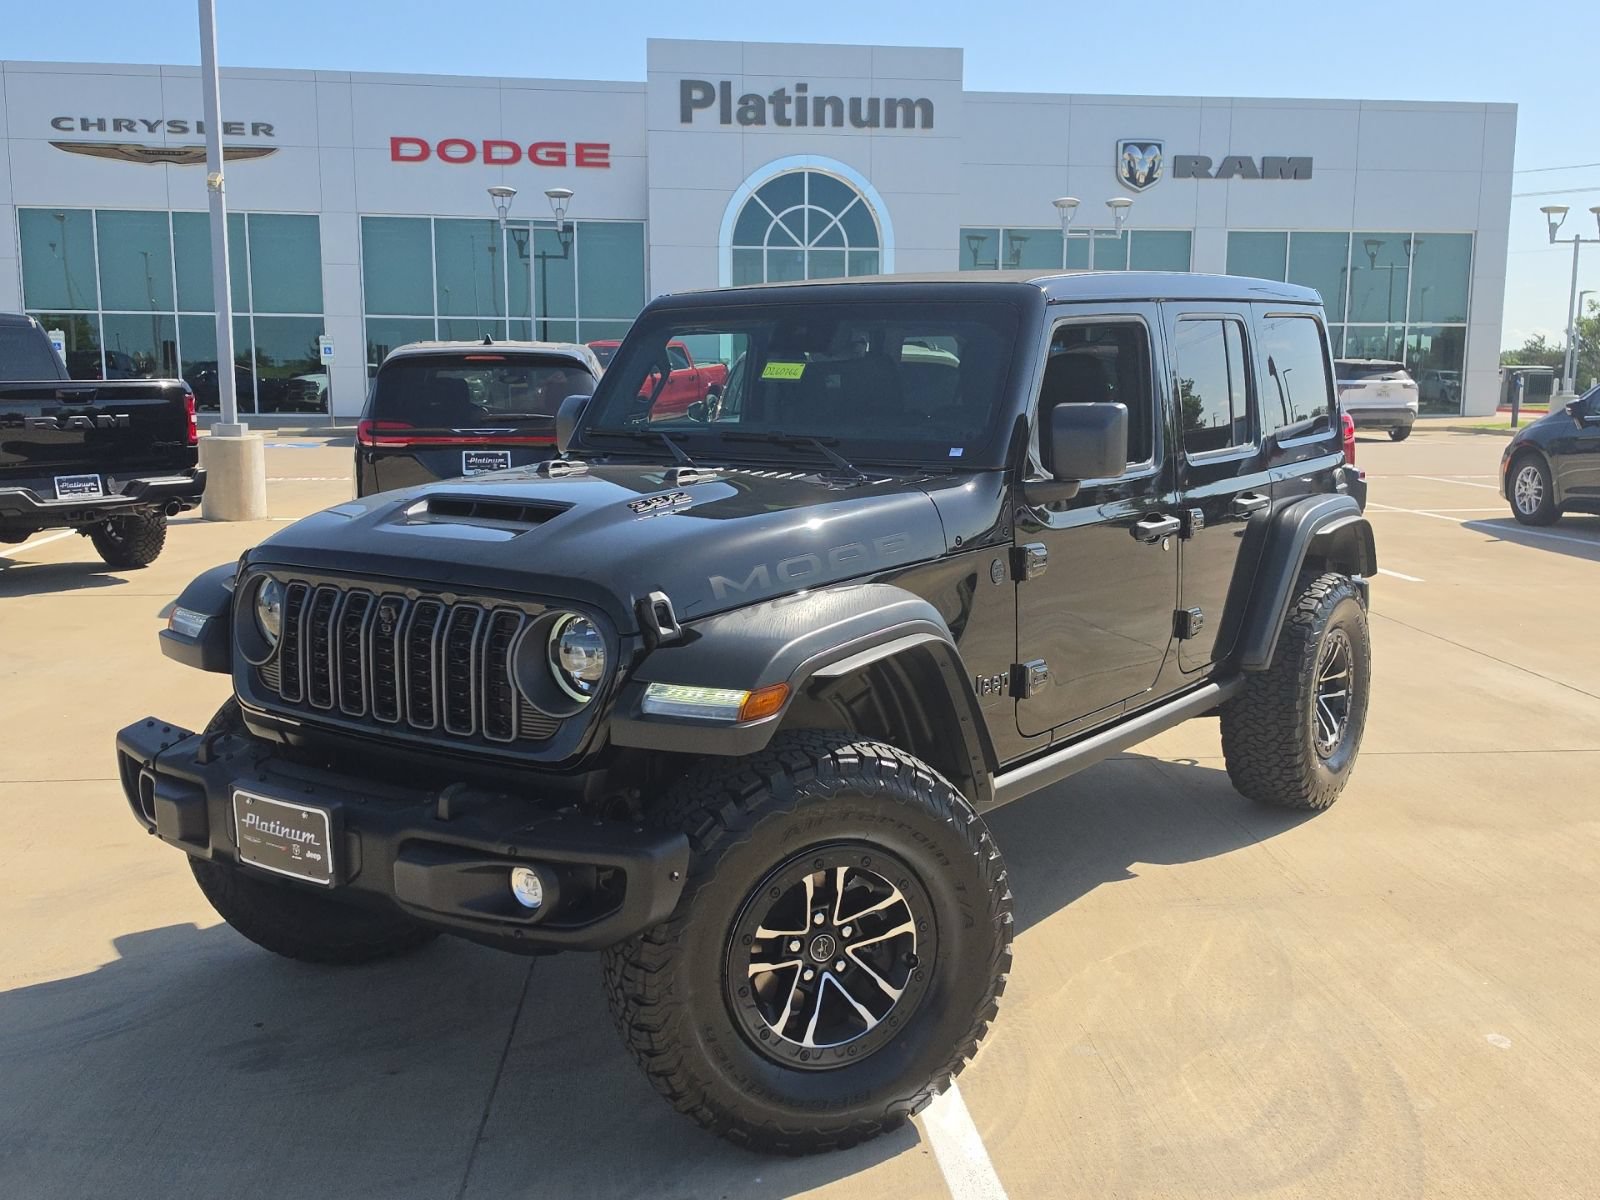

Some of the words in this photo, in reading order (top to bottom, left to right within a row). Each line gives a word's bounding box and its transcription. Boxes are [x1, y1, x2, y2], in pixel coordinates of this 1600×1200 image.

[680, 79, 934, 129] Platinum
[50, 116, 275, 137] CHRYSLER
[390, 137, 610, 168] DODGE
[1174, 155, 1313, 179] RAM
[24, 414, 131, 430] RAM
[59, 481, 98, 489] Platinum
[627, 492, 693, 514] 392
[709, 532, 910, 600] MOAB
[241, 812, 321, 846] Platinum
[305, 850, 322, 862] Jeep
